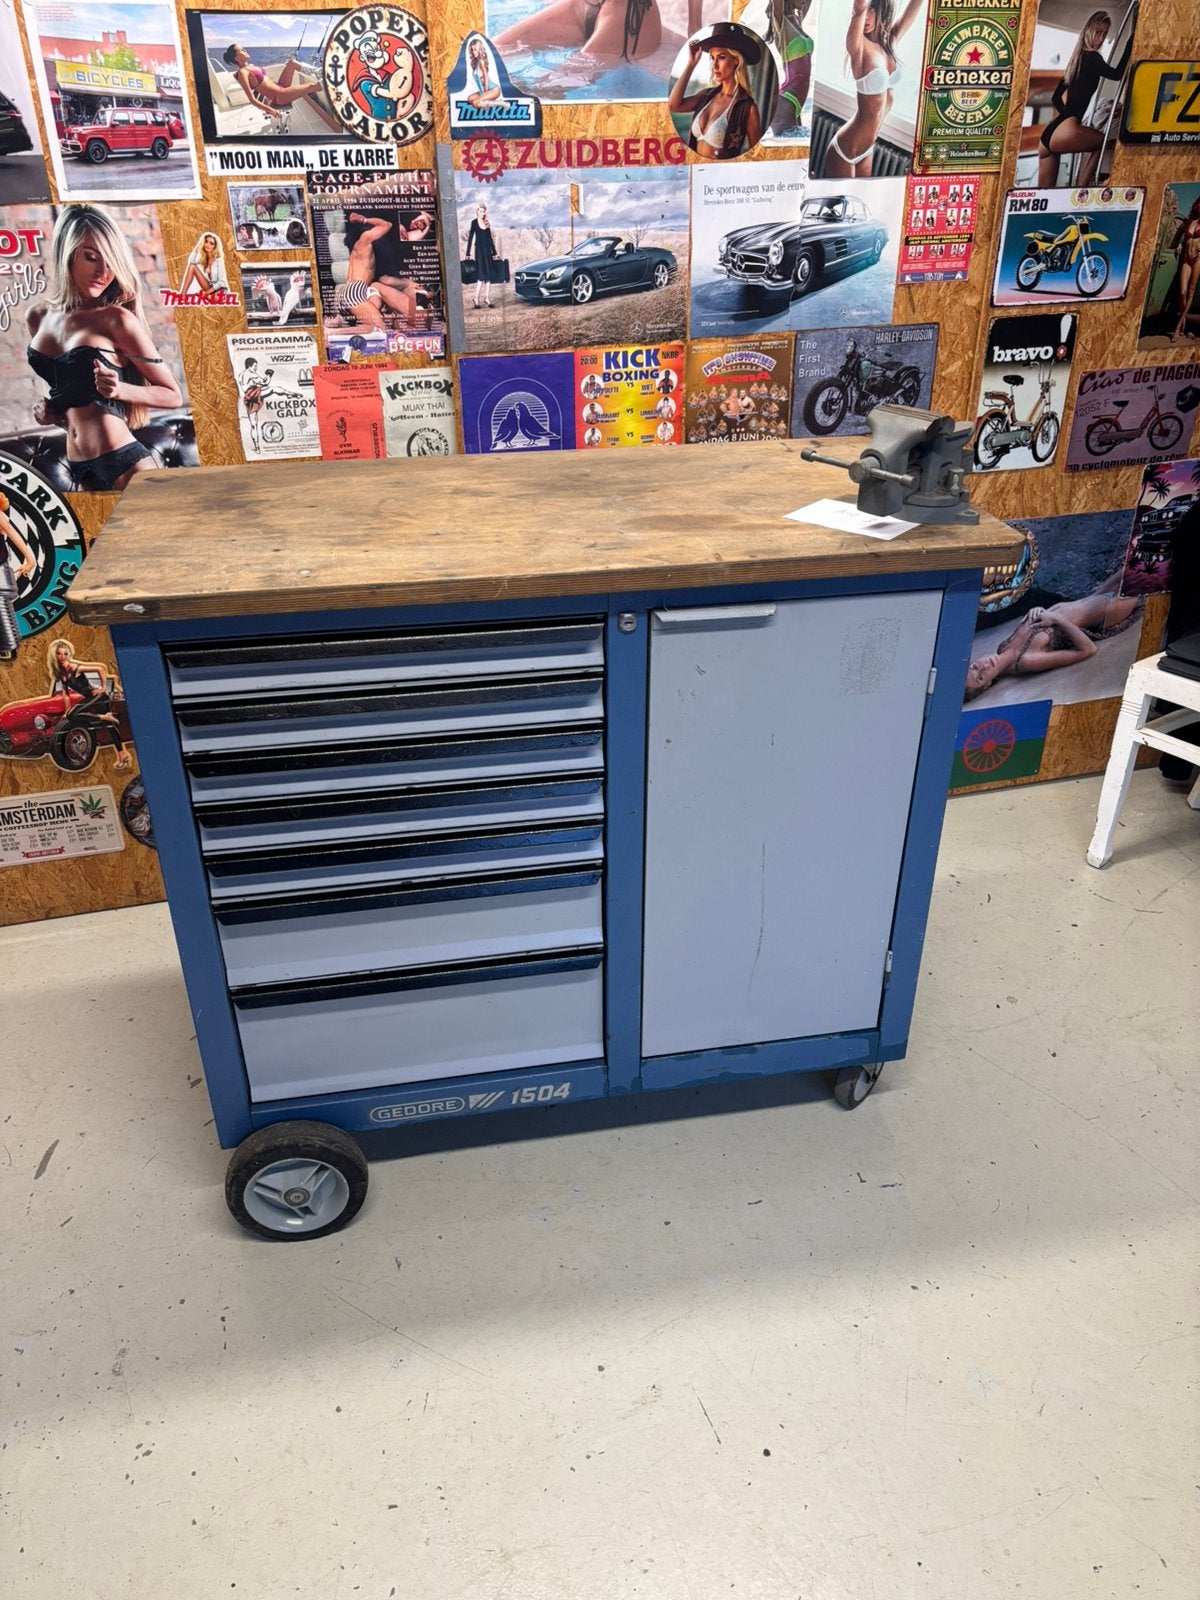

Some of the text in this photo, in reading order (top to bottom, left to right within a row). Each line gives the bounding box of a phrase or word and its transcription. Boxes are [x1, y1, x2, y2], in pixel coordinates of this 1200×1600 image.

[333, 10, 429, 63] POPEYE
[75, 70, 144, 89] BICYCLES
[932, 127, 993, 136] PREMIUM QUALITY
[1163, 133, 1182, 142] Auto
[319, 149, 339, 168] DE
[344, 148, 395, 168] KARRE
[515, 137, 687, 168] ZUIDBERG
[312, 171, 431, 184] CAGE-FIGHT
[313, 184, 430, 196] TOURNAMENT
[704, 185, 714, 196] De
[716, 184, 760, 197] sportwagen
[761, 184, 775, 193] van
[776, 182, 786, 192] de
[231, 335, 313, 346] PROGRAMMA
[415, 339, 441, 352] FUN
[800, 339, 818, 350] The
[604, 348, 661, 370] KICK
[799, 353, 821, 364] First
[993, 344, 1054, 363] bravo
[725, 352, 775, 370] SHOWTIME
[602, 369, 660, 383] BOXING
[716, 365, 763, 375] AMSTERDAM
[798, 366, 826, 377] Brand
[1078, 370, 1127, 396] Ciao
[1132, 368, 1151, 384] de
[265, 399, 317, 410] KICKBOX
[402, 402, 446, 412] MUAY THAI
[276, 408, 308, 418] GALA
[731, 433, 738, 441] 8
[739, 432, 759, 441] JUNI
[23, 799, 39, 809] the
[4, 821, 49, 832] COFFEESHOP
[377, 1082, 571, 1120] GEDORE 1504
